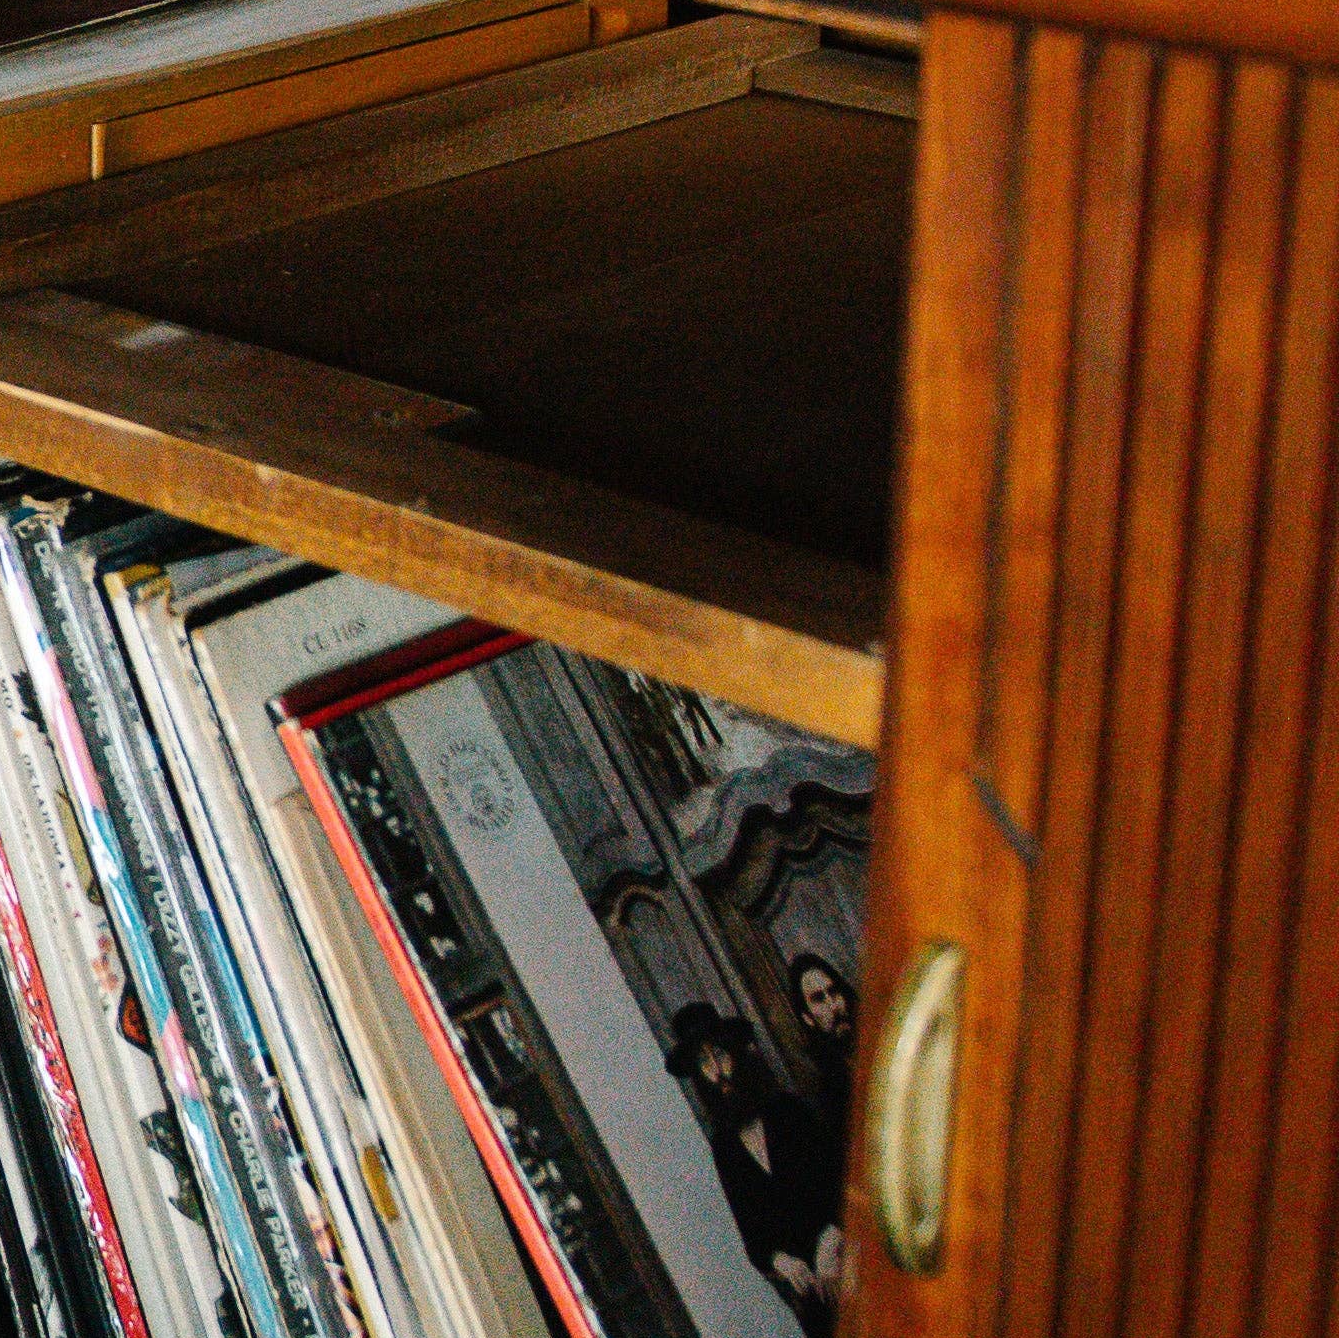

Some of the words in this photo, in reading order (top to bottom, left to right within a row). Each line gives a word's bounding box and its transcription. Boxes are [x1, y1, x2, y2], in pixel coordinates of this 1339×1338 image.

[21, 752, 66, 870] OKLAHOMA
[151, 887, 188, 958] DIZZY
[177, 962, 228, 1080] GILLESPIE
[217, 1082, 236, 1106] &
[226, 1109, 274, 1212] CHARLIE
[264, 1214, 309, 1313] PARKER
